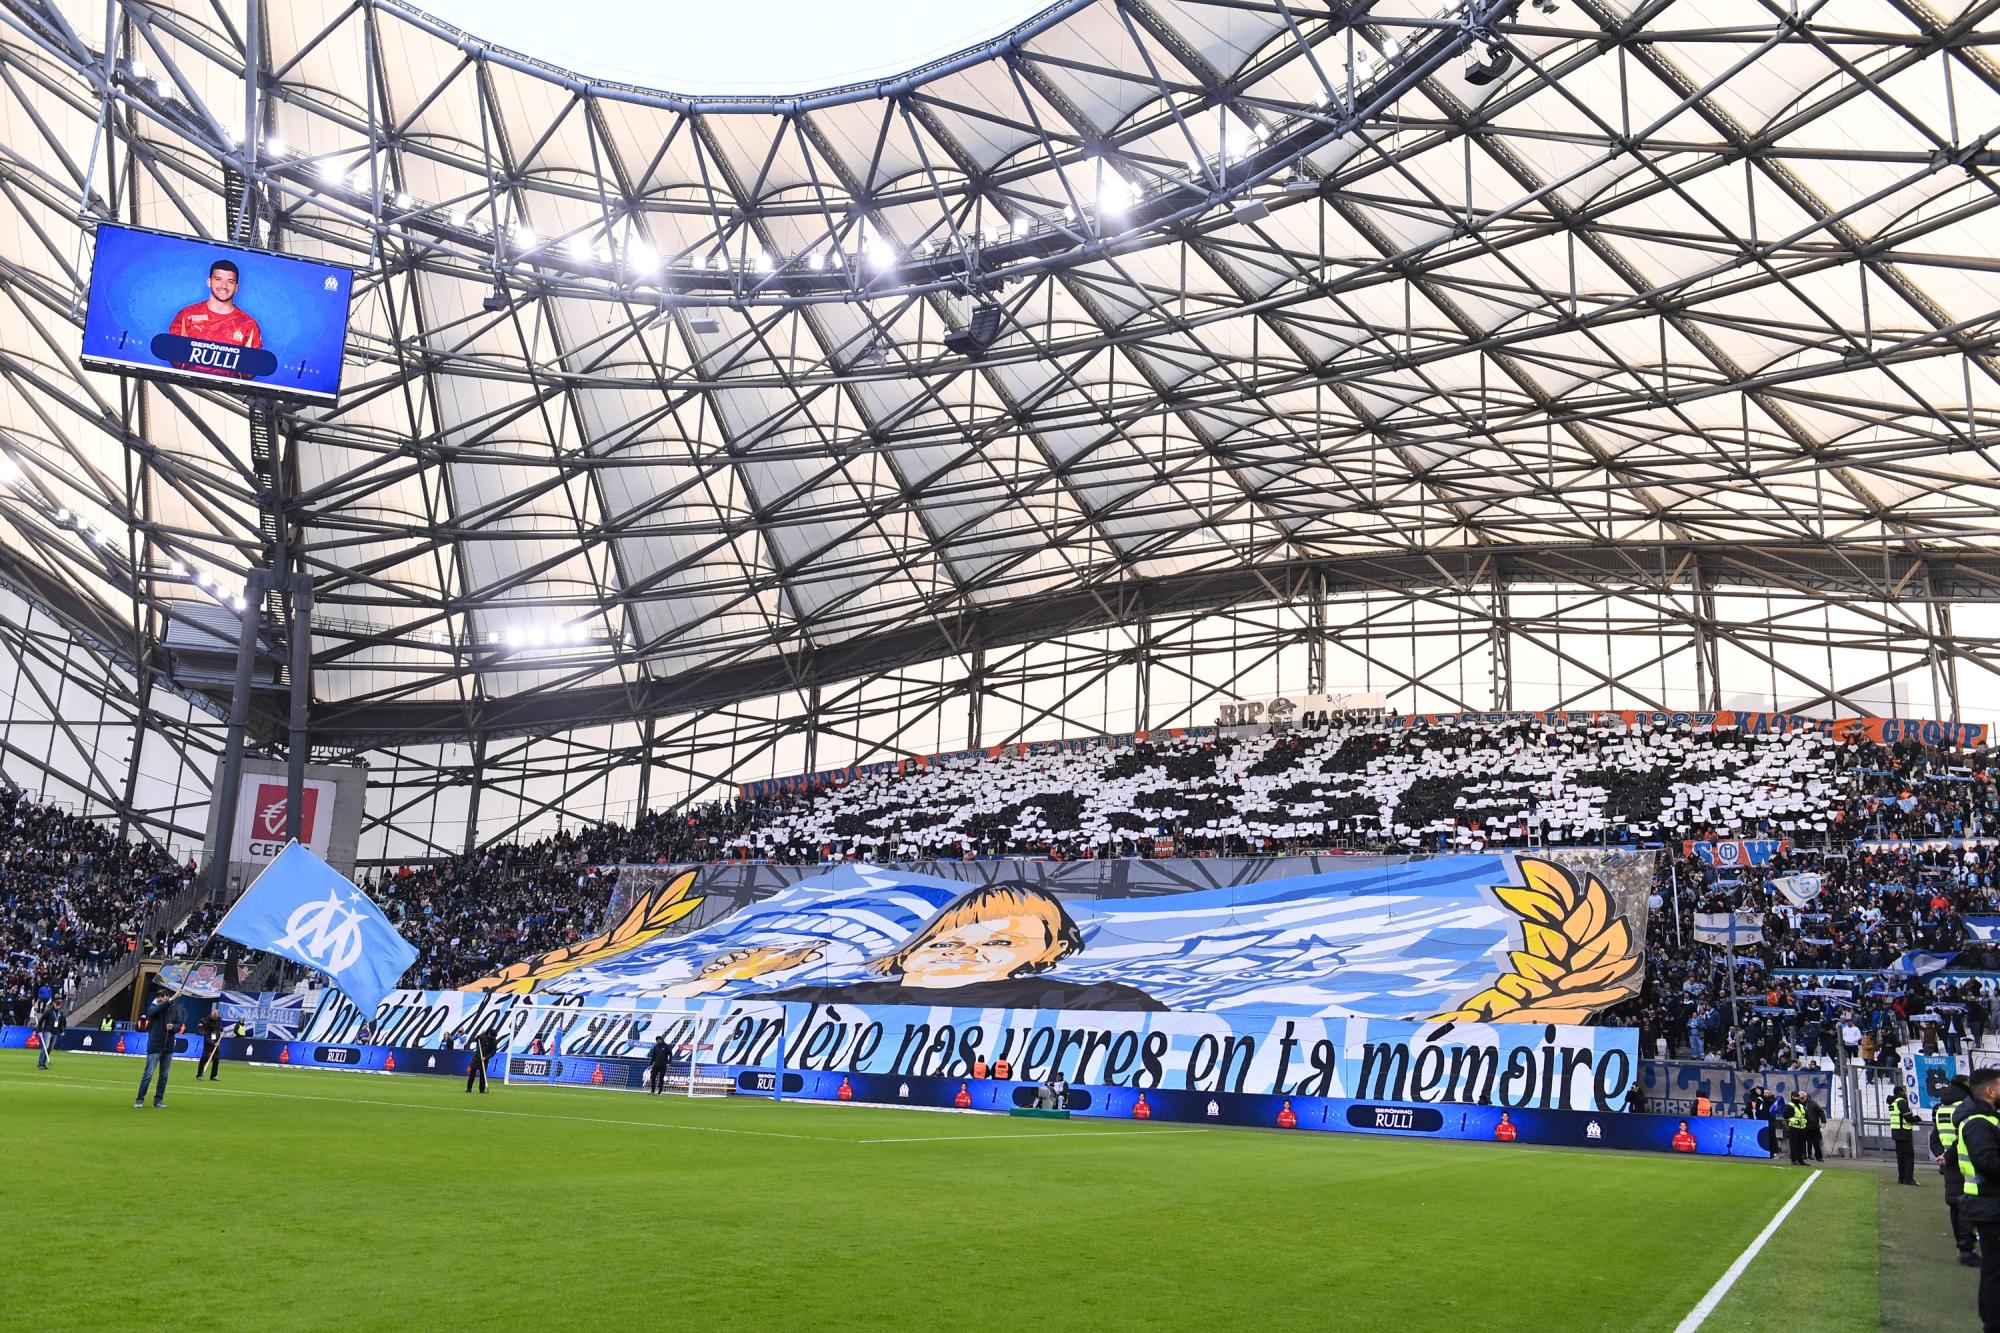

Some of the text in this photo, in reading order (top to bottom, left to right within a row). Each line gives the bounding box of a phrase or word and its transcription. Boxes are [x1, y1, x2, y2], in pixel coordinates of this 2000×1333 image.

[190, 341, 240, 354] GERÓNIMO
[189, 348, 240, 369] RULLI
[1219, 702, 1386, 731] RIP GASSET
[1634, 711, 1718, 728] 1987
[1882, 719, 1982, 749] GROUP
[249, 842, 311, 857] CEP
[241, 1007, 294, 1024] MARSEILLE
[790, 1002, 884, 1074] lève
[892, 1023, 984, 1078] nos
[1004, 1026, 1169, 1089] verres
[1185, 1034, 1256, 1094] en
[1271, 1021, 1336, 1097] ta
[1355, 1022, 1630, 1113] mémoire
[523, 1064, 545, 1076] RULLI
[756, 1077, 776, 1090] RUL
[1644, 1098, 1748, 1118] MARSLLE
[1375, 1113, 1413, 1129] RULLI
